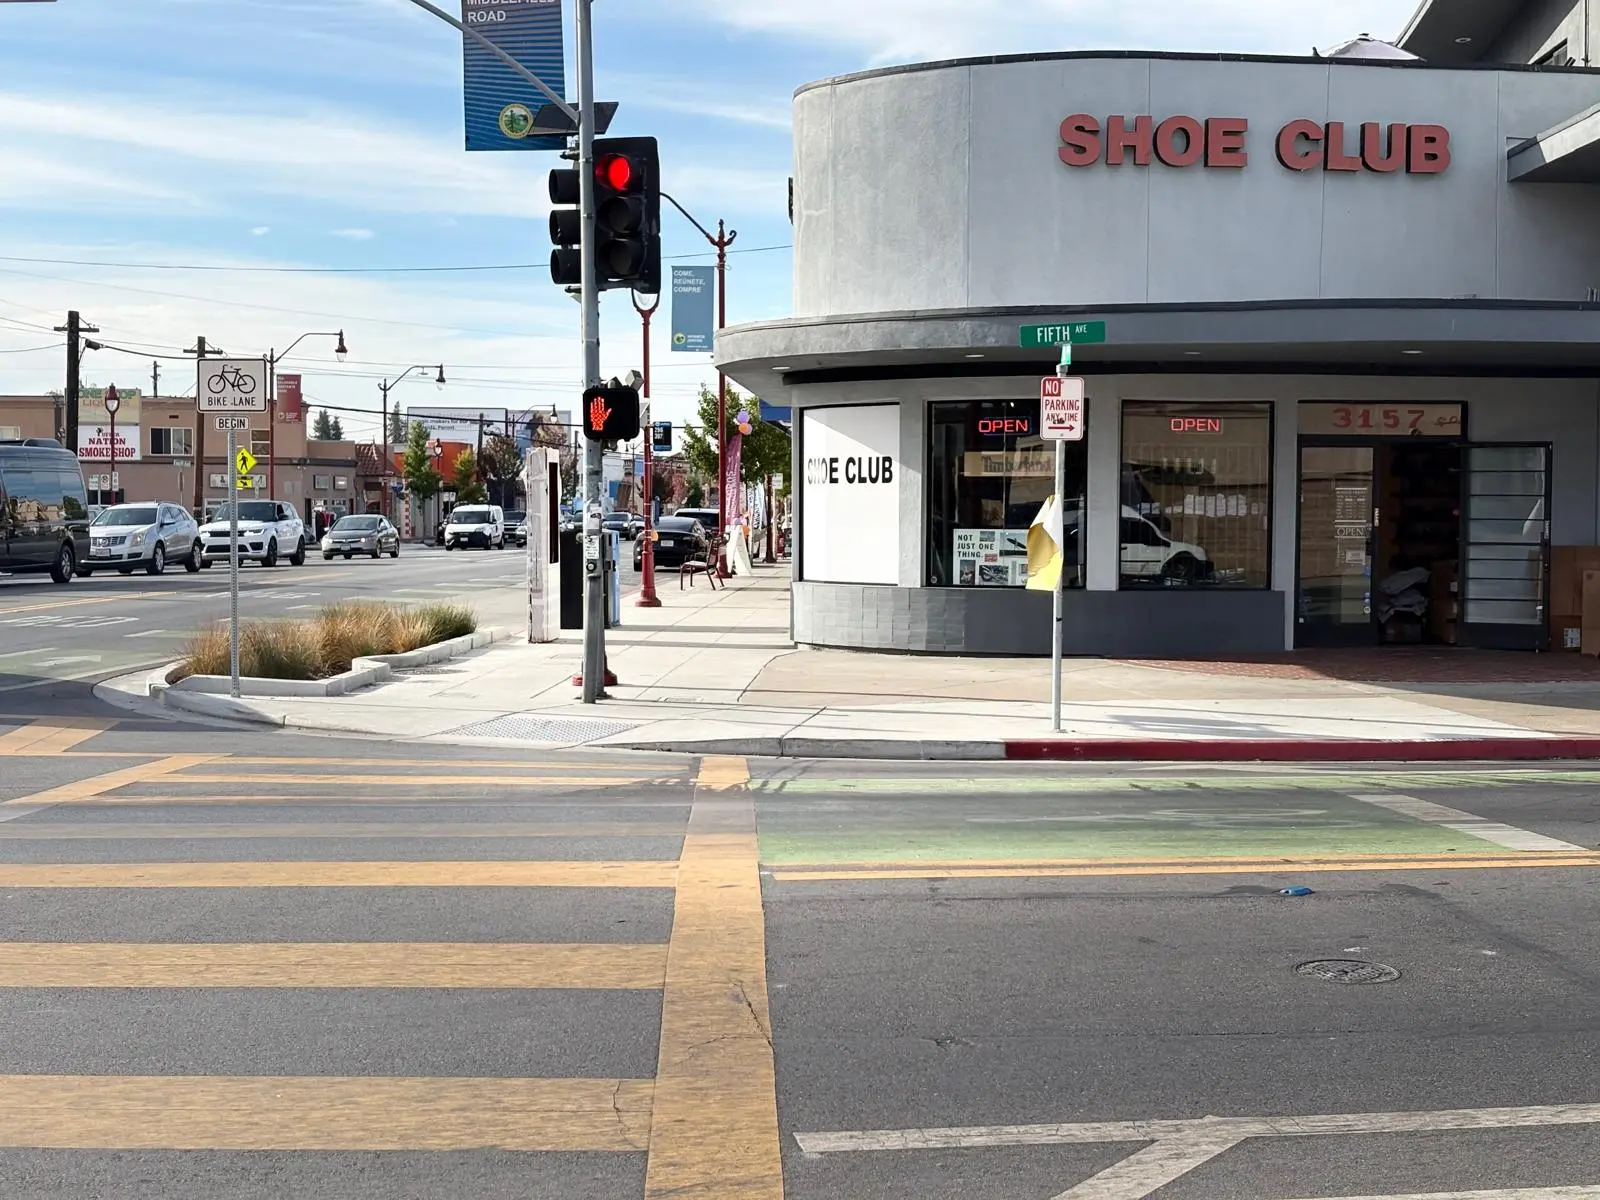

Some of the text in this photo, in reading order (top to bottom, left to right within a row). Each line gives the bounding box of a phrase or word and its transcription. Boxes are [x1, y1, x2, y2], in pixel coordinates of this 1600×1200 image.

[468, 10, 507, 23] ROAD
[1058, 113, 1452, 174] SHOE CLUB
[1037, 324, 1088, 343] FIFTH AVE
[1045, 380, 1059, 395] NO
[207, 396, 257, 407] BIKE LANE
[1044, 399, 1080, 411] PARKING
[1045, 412, 1078, 422] ANY TIME
[1332, 407, 1425, 429] 3157
[218, 418, 246, 429] BEGIN
[978, 419, 1028, 433] OPEN
[1171, 418, 1220, 431] OPEN
[88, 437, 126, 445] NATON
[79, 447, 136, 458] SMOKE SHOP
[845, 455, 893, 484] CLUB
[1336, 526, 1365, 536] OPEN
[957, 542, 976, 550] JUST
